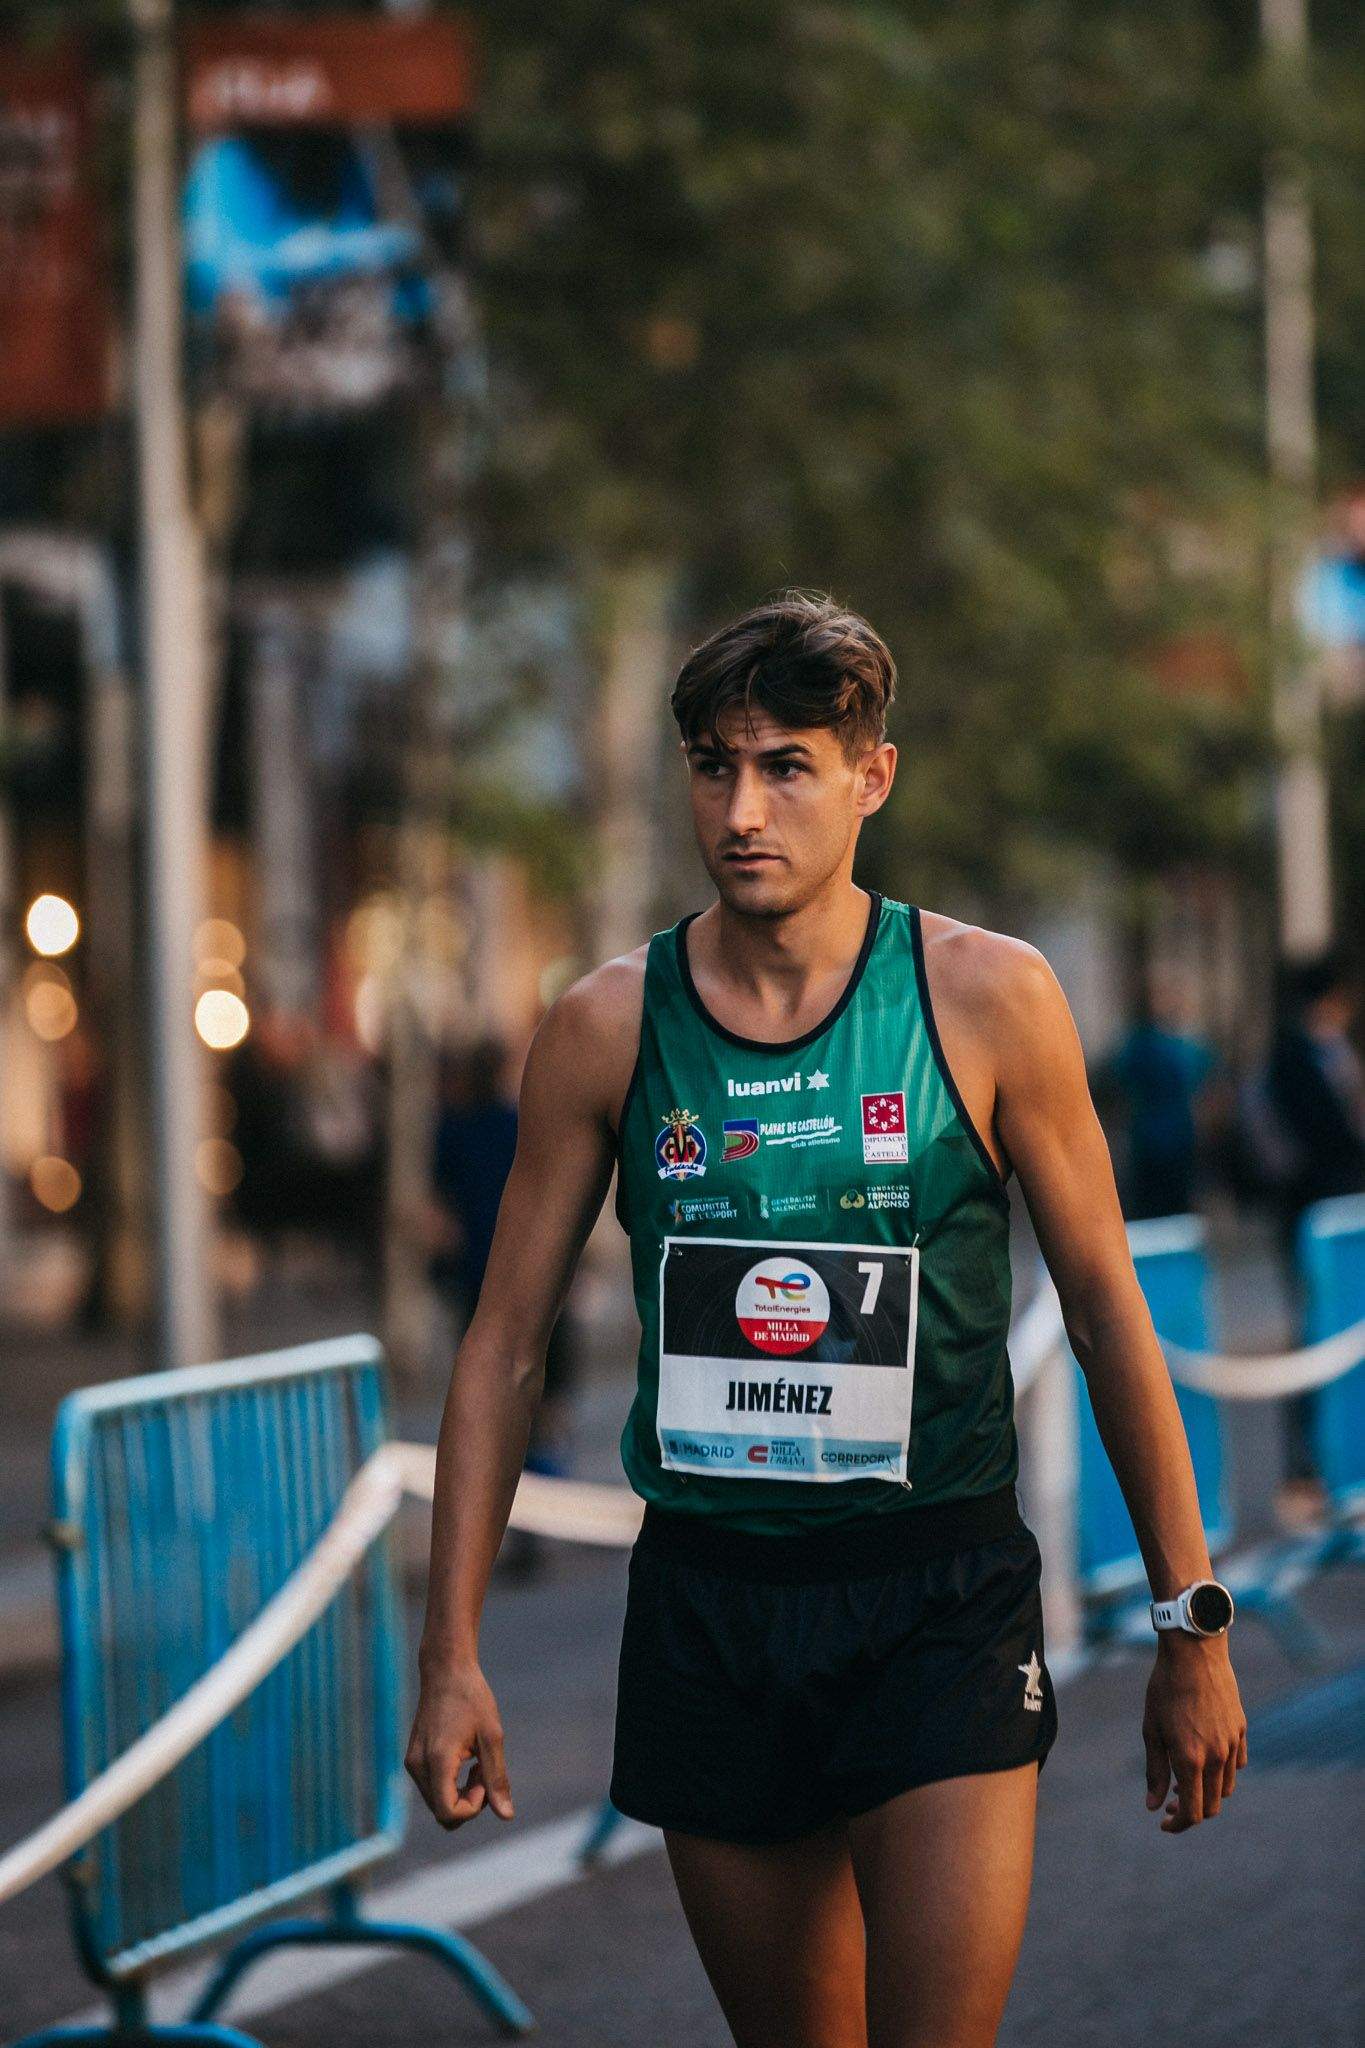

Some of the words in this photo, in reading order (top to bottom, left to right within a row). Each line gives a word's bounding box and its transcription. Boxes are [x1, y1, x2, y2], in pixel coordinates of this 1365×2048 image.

[728, 1072, 801, 1097] luanvi
[760, 1122, 785, 1136] PLAYAS
[787, 1121, 797, 1134] DE
[798, 1114, 835, 1132] CASTELLÓN
[791, 1141, 807, 1149] club
[771, 1195, 816, 1206] GENERALITAT
[867, 1192, 910, 1201] TRINIDAD
[681, 1201, 730, 1214] COMUNITAT
[772, 1203, 817, 1213] VALENCIANA
[868, 1200, 910, 1210] ALFONSO
[685, 1213, 696, 1222] DE
[858, 1261, 884, 1315] 7
[755, 1304, 811, 1315] TotalEnergies
[767, 1321, 799, 1332] MILLA
[754, 1331, 768, 1341] DE
[770, 1332, 810, 1342] MADRID
[726, 1378, 833, 1415] JIMÉNEZ
[683, 1442, 735, 1459] MADRID
[771, 1445, 801, 1457] MILLA
